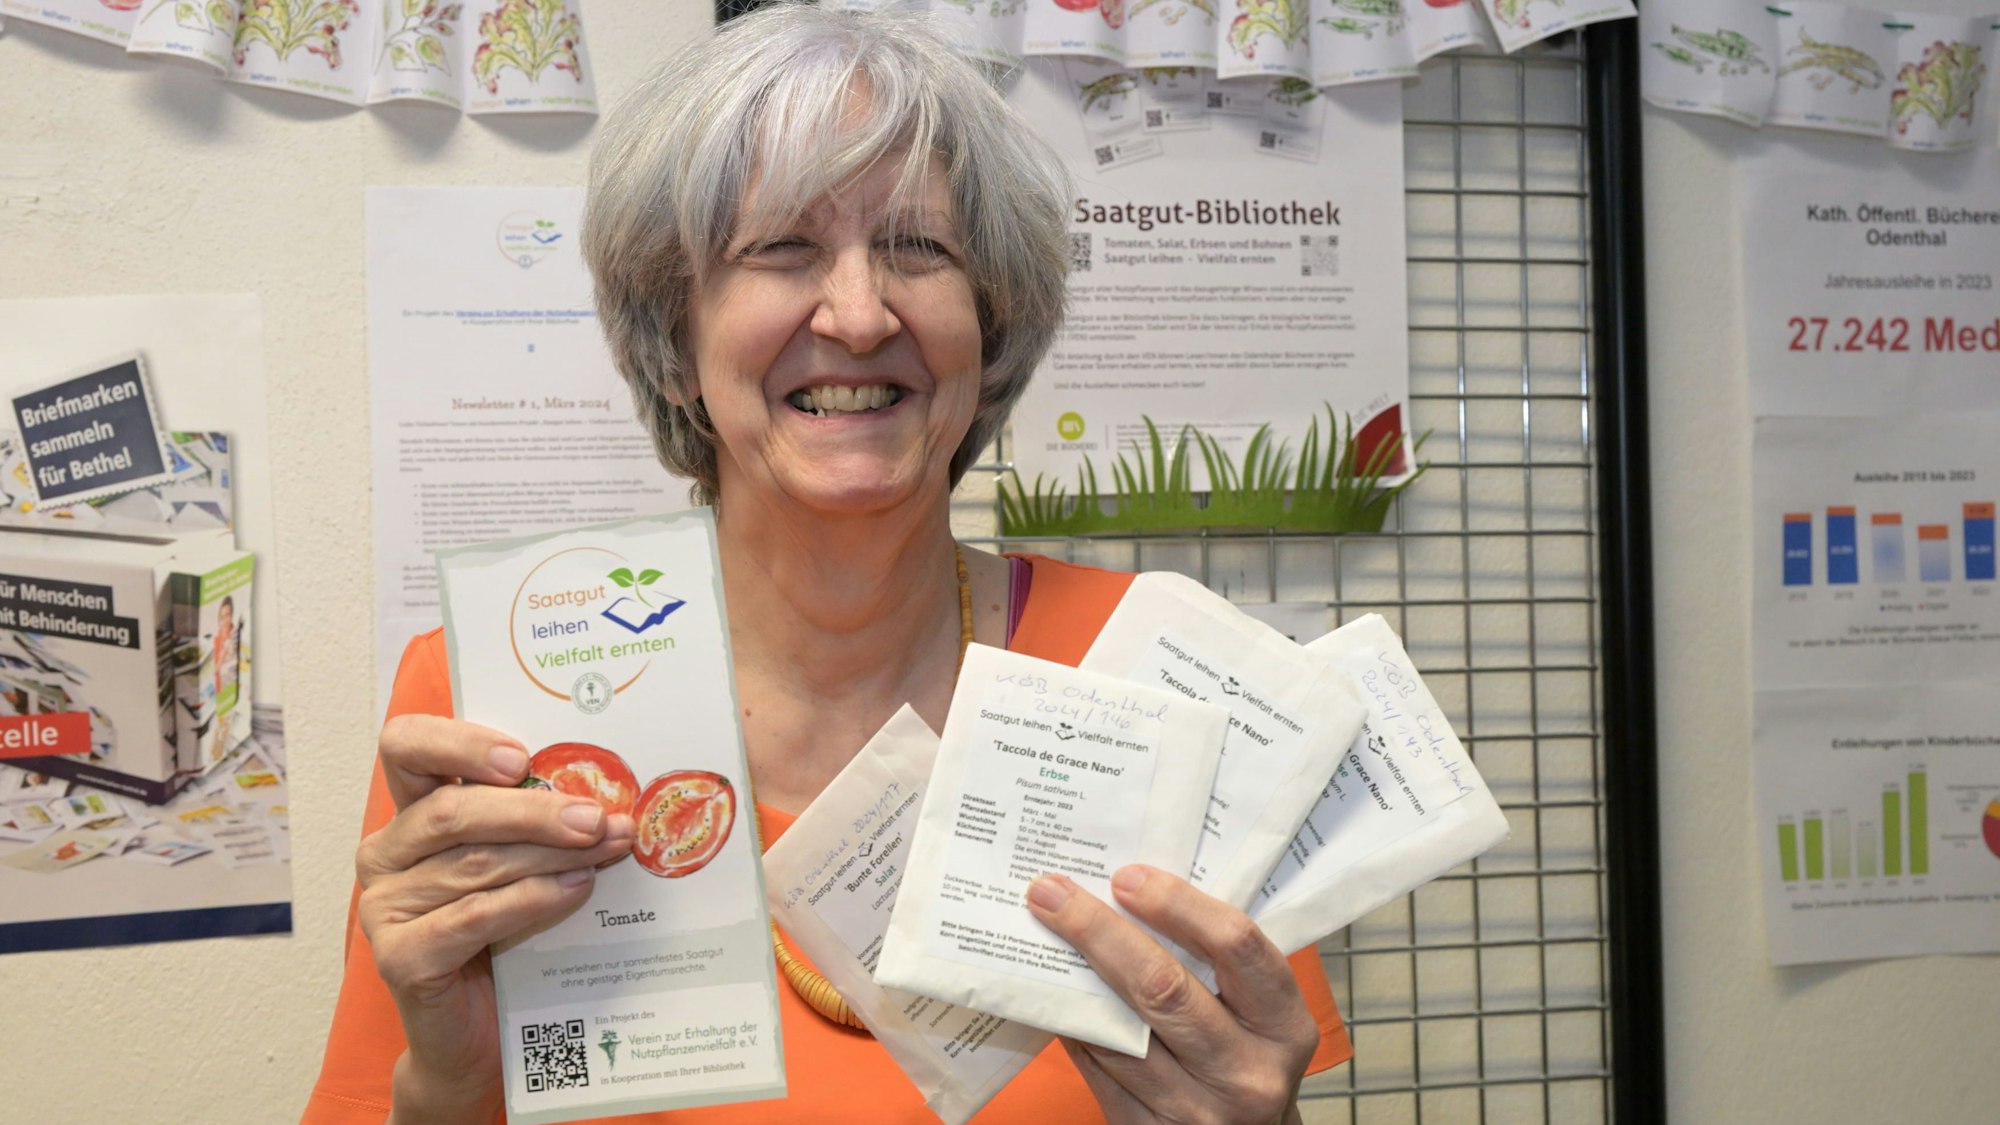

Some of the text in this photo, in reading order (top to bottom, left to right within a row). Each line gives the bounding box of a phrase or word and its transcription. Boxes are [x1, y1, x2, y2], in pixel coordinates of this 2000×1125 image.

[1074, 198, 1341, 230] Saatgut-Bibliothek
[1806, 202, 2000, 225] Kath. Öffentl. Büchere
[1103, 237, 1292, 250] Tomaten, Salat, Erbsen und Bohnen
[1865, 228, 1947, 247] Odenthal
[1104, 252, 1276, 265] Saatgut leihen Vielfalt ernten
[1824, 273, 1992, 290] Jahresausleihe in 2023
[1787, 316, 1910, 352] 27.242
[21, 380, 139, 428] Briefmarken
[452, 396, 515, 410] Newsletter
[544, 396, 576, 409] März
[579, 398, 611, 411] 2024
[30, 420, 115, 459] sammeln
[38, 446, 133, 488] für Bethel
[0, 580, 108, 611] ür Menschen
[527, 584, 606, 610] Saatgut
[19, 610, 130, 646] Behinderung
[531, 619, 589, 640] leihen
[534, 636, 676, 669] Vielfalt ernten
[1157, 636, 1304, 735] Saatgut leihen Vielfalt ernten
[585, 698, 600, 706] VEN
[1160, 668, 1274, 746] 'Taccola Nano'
[980, 708, 1149, 753] Saatgut leihen Vielfalt ernten
[1927, 735, 2000, 747] Kinderbüche
[993, 739, 1125, 777] 'Taccola de Grace Nano'
[1038, 766, 1071, 782] Erbse
[1349, 752, 1393, 811] Grace Nano'
[1380, 752, 1425, 816] Vielfalt ernten
[962, 793, 996, 807] Direktsaat
[1015, 777, 1087, 801] Pisum sativum L.
[960, 802, 1006, 819] Pflanzabstand
[1022, 806, 1057, 820] März Mai
[1023, 794, 1074, 811] Erntejahr: 2023
[956, 821, 998, 836] Küchenernte
[958, 812, 996, 826] Wuchshöhe
[807, 791, 919, 906] Saatgut leihen Vielfalt ernten
[954, 830, 994, 845] Samenernte
[1015, 834, 1057, 849] Juni August
[1018, 824, 1028, 833] 50
[1040, 830, 1070, 842] Rankhilfe
[1071, 838, 1108, 851] notwendig!
[844, 832, 903, 893] 'Bunte Forellen'
[1012, 854, 1059, 869] rascheltrocken
[1014, 843, 1105, 871] Die ersten Hülsen vollständig
[874, 864, 897, 888] Salat
[871, 885, 896, 911] Lactuca
[595, 908, 656, 929] Tomate
[939, 929, 956, 939] Korn
[956, 934, 991, 947] eingetütet
[1006, 945, 1019, 953] mit
[1018, 948, 1032, 956] den
[1046, 954, 1093, 971] Informatione
[940, 920, 957, 930] Bitte
[957, 924, 984, 935] bringen
[984, 930, 995, 938] Sie
[1007, 935, 1041, 949] Portionen
[1040, 943, 1066, 955] Saatgut
[1067, 950, 1079, 958] mit
[541, 947, 724, 978] Wir verleihen nur samenfestes Saatgut
[958, 943, 995, 957] beschriftet
[994, 952, 1017, 963] zurück
[1025, 959, 1039, 968] Ihre
[1039, 962, 1070, 975] Bücherei.
[560, 963, 707, 989] ohne geistige Eigentumsrechte.
[594, 1010, 656, 1025] Ein Projekt des
[627, 1021, 758, 1046] Verein zur Erhaltung der
[630, 1035, 758, 1060] Nutzpflanzenvielfalt e.V.
[600, 1061, 746, 1085] in Kooperation mit Ihrer Bibliothek
